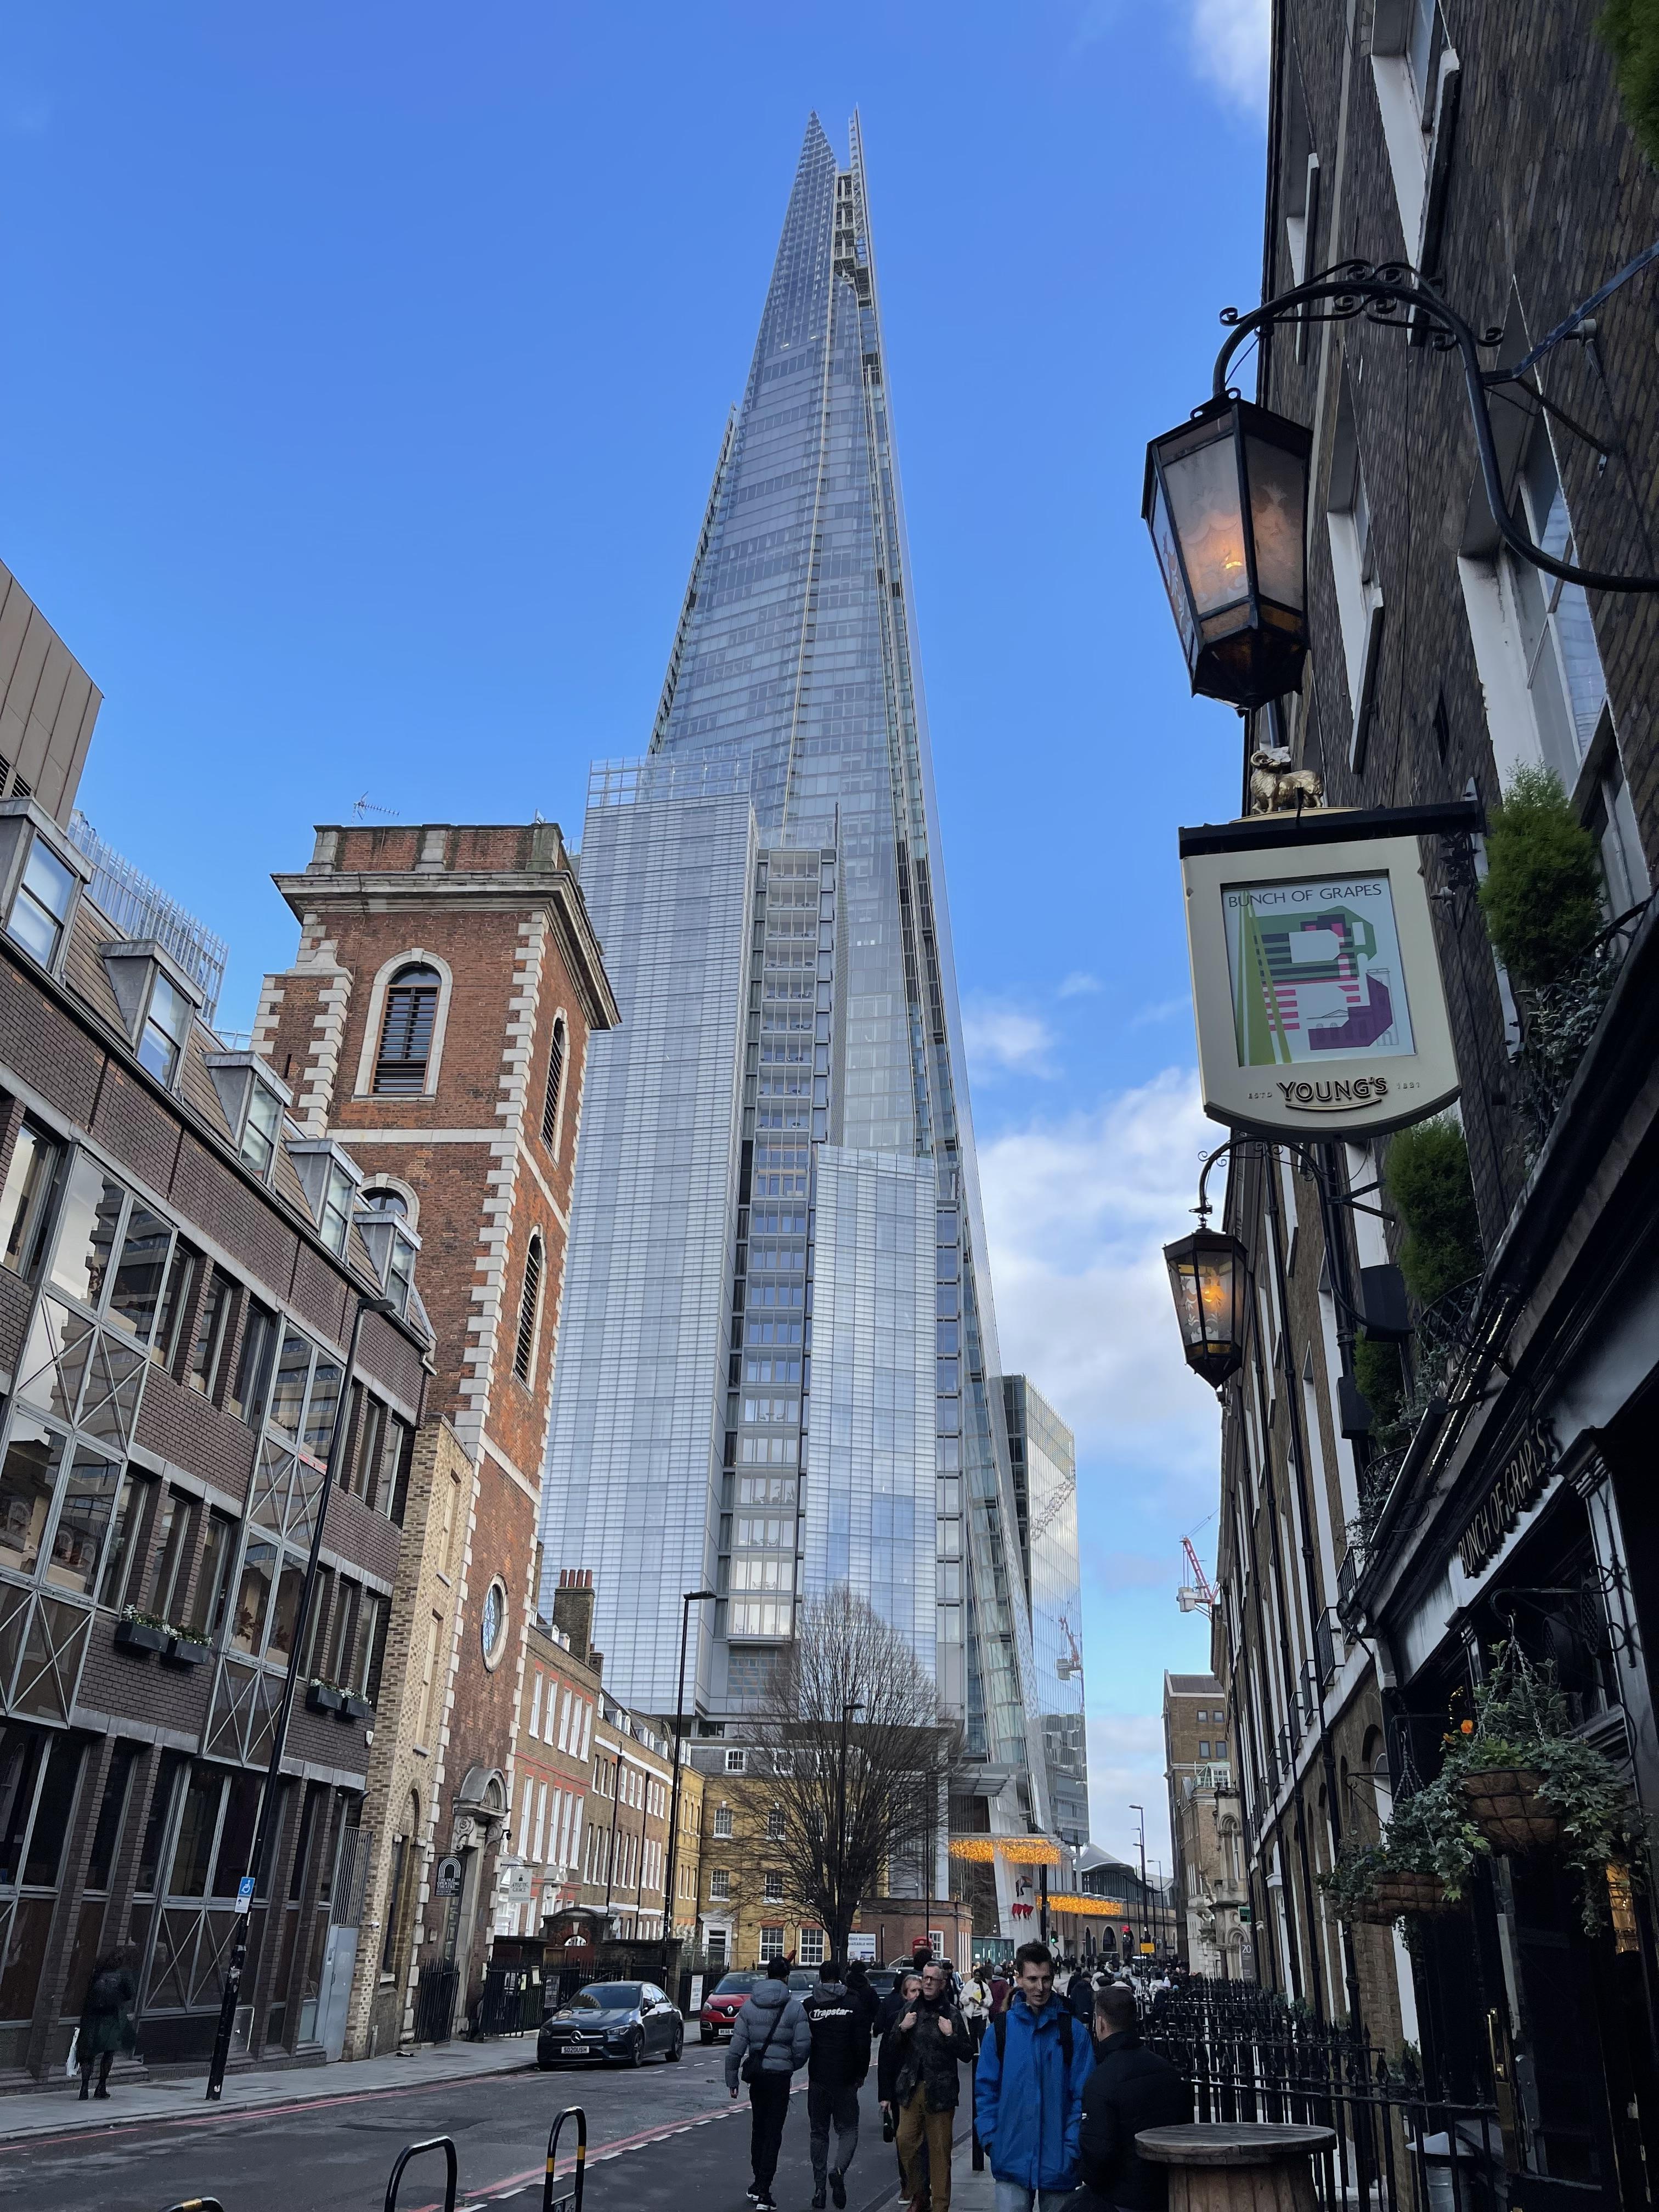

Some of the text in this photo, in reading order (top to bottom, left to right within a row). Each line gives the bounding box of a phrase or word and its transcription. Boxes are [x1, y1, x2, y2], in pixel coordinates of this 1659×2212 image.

[1228, 884, 1382, 907] BUNCH OF GRAPES
[1276, 1077, 1388, 1102] YOUNG'S
[1458, 1505, 1491, 1578] BUNCH
[1490, 1482, 1504, 1534] OF
[1242, 1944, 1251, 1953] 20
[813, 2007, 849, 2018] Trapstar
